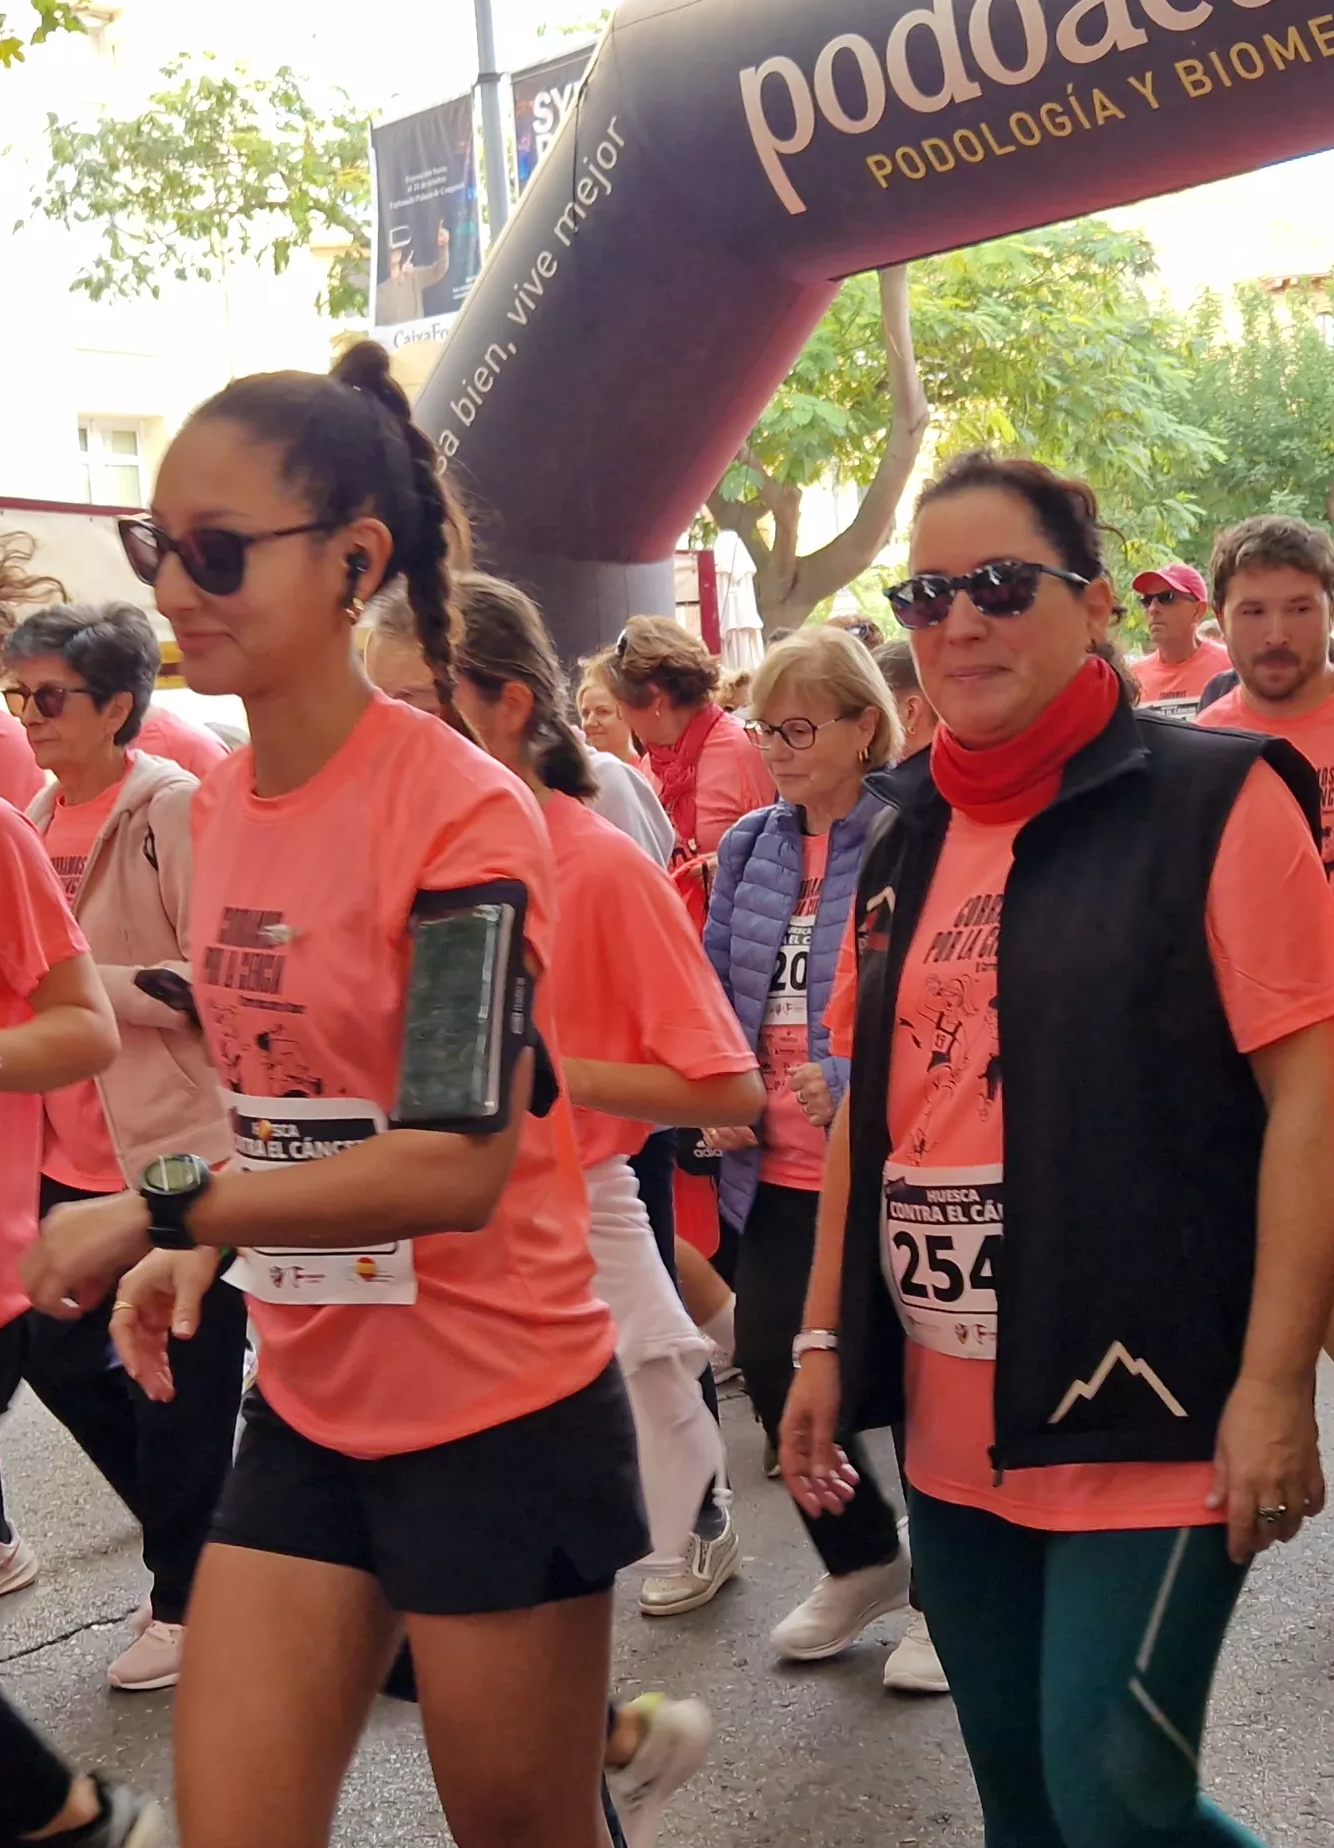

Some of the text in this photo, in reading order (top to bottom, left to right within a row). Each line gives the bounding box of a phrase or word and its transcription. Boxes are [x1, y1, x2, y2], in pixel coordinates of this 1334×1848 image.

[531, 80, 583, 134] SY
[866, 82, 1126, 190] PODOLOGÍA
[1126, 70, 1160, 110] Y
[449, 340, 518, 428] bien,
[506, 250, 559, 326] vive
[552, 115, 626, 247] mejor
[923, 931, 962, 964] POR
[957, 928, 982, 961] LA
[889, 1202, 945, 1223] CONTRA
[946, 1204, 969, 1223] EL
[925, 1188, 981, 1204] HUESCA
